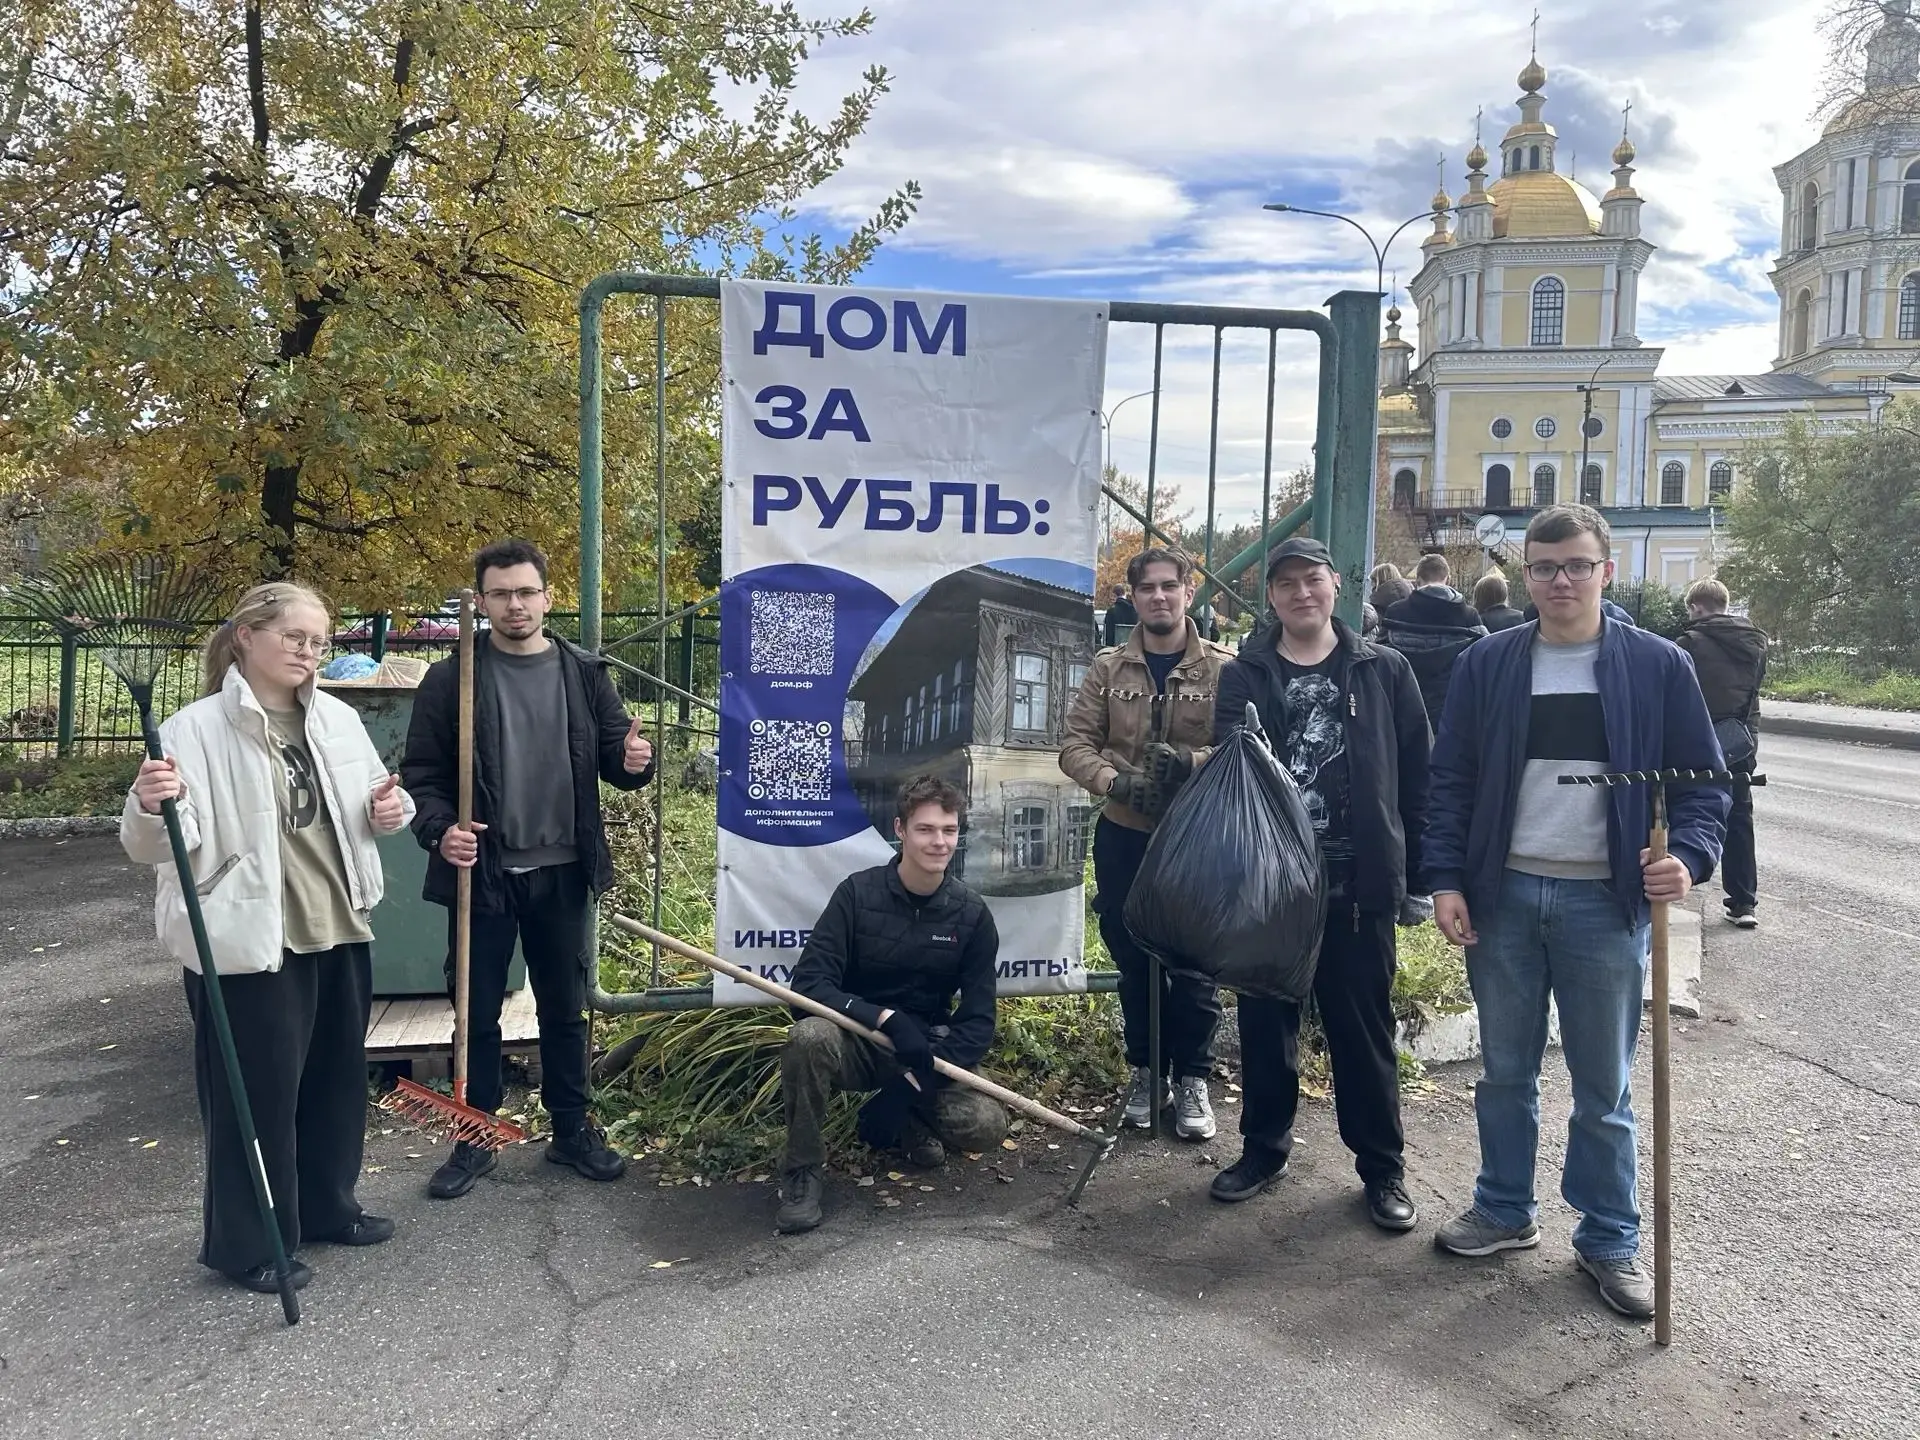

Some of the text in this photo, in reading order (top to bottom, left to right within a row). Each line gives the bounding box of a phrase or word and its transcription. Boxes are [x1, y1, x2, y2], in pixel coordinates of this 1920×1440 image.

[753, 291, 967, 358] ДОМ
[753, 384, 871, 442] ЗА
[753, 474, 1051, 536] РУБЛЬ:
[770, 680, 813, 689] дом.рф
[744, 808, 834, 817] дополнительная
[756, 818, 822, 826] иформация
